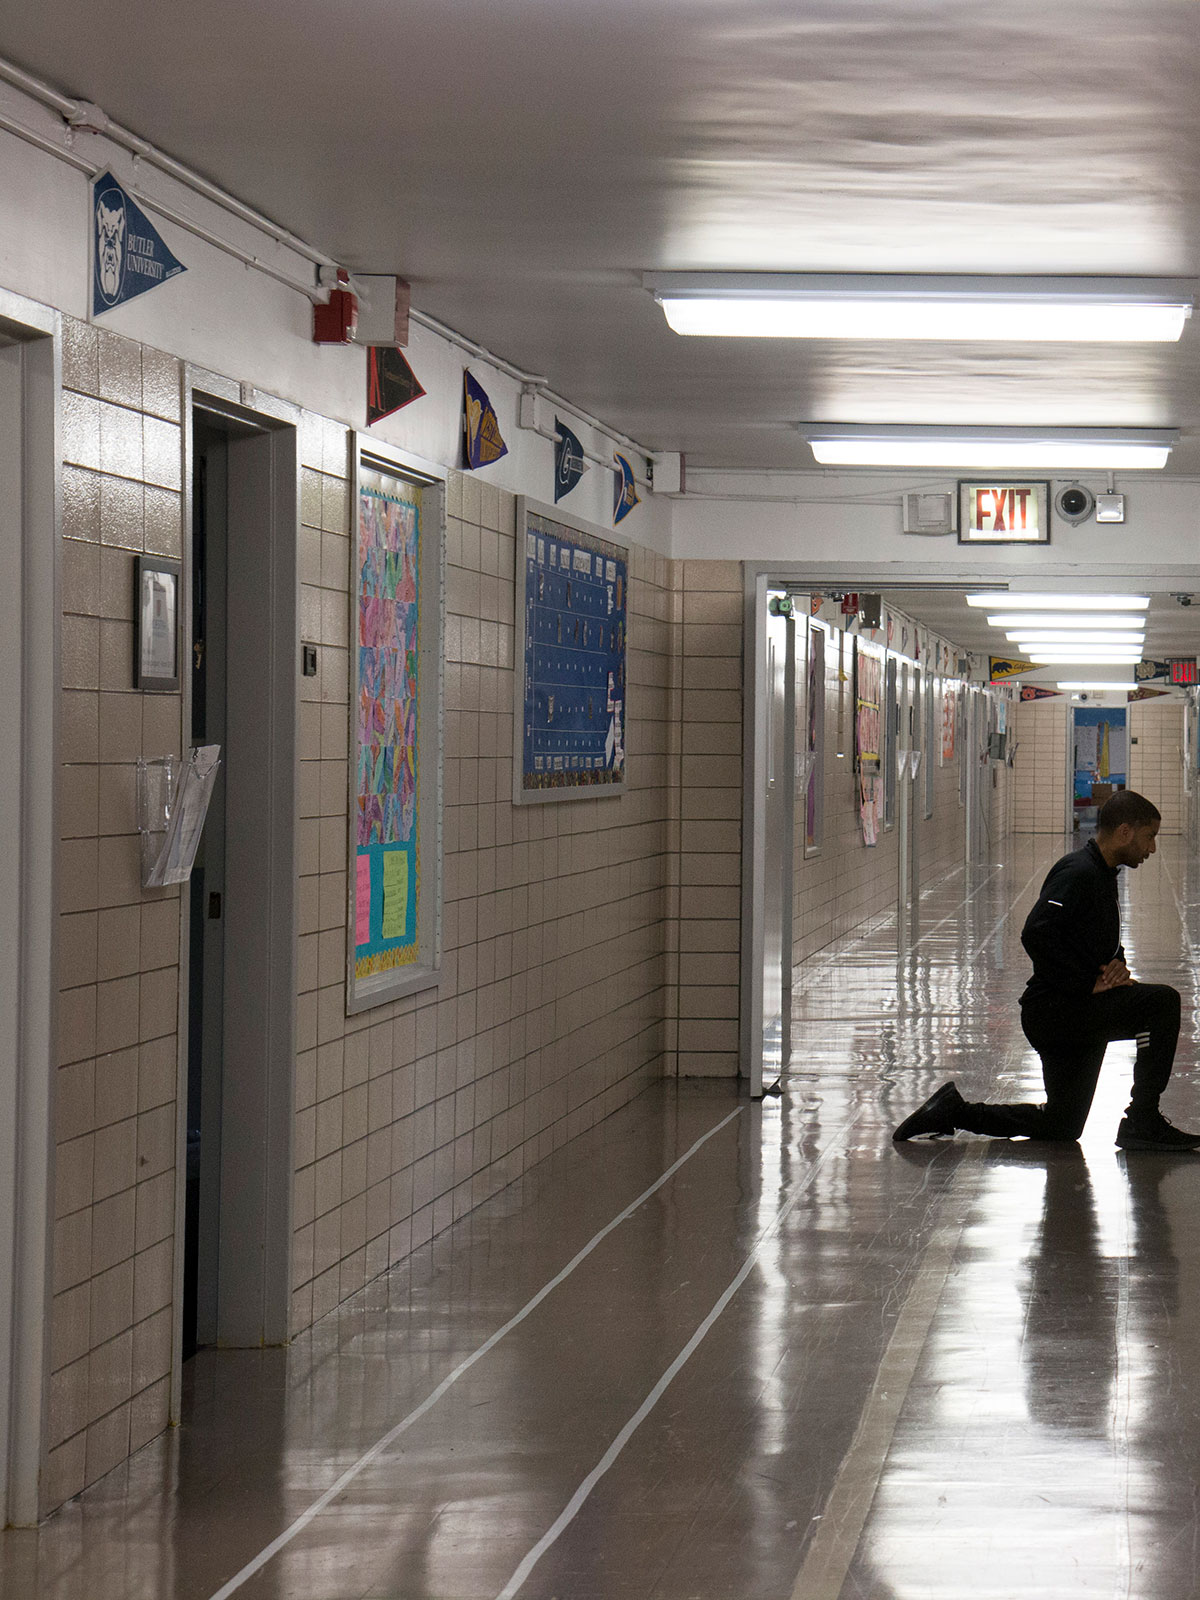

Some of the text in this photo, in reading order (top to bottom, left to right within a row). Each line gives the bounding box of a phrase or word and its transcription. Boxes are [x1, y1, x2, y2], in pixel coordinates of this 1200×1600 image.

[127, 233, 154, 257] BUTLER
[127, 253, 165, 280] UNIVERSITY
[976, 488, 1031, 531] EXIT
[1172, 663, 1197, 683] EXIT
